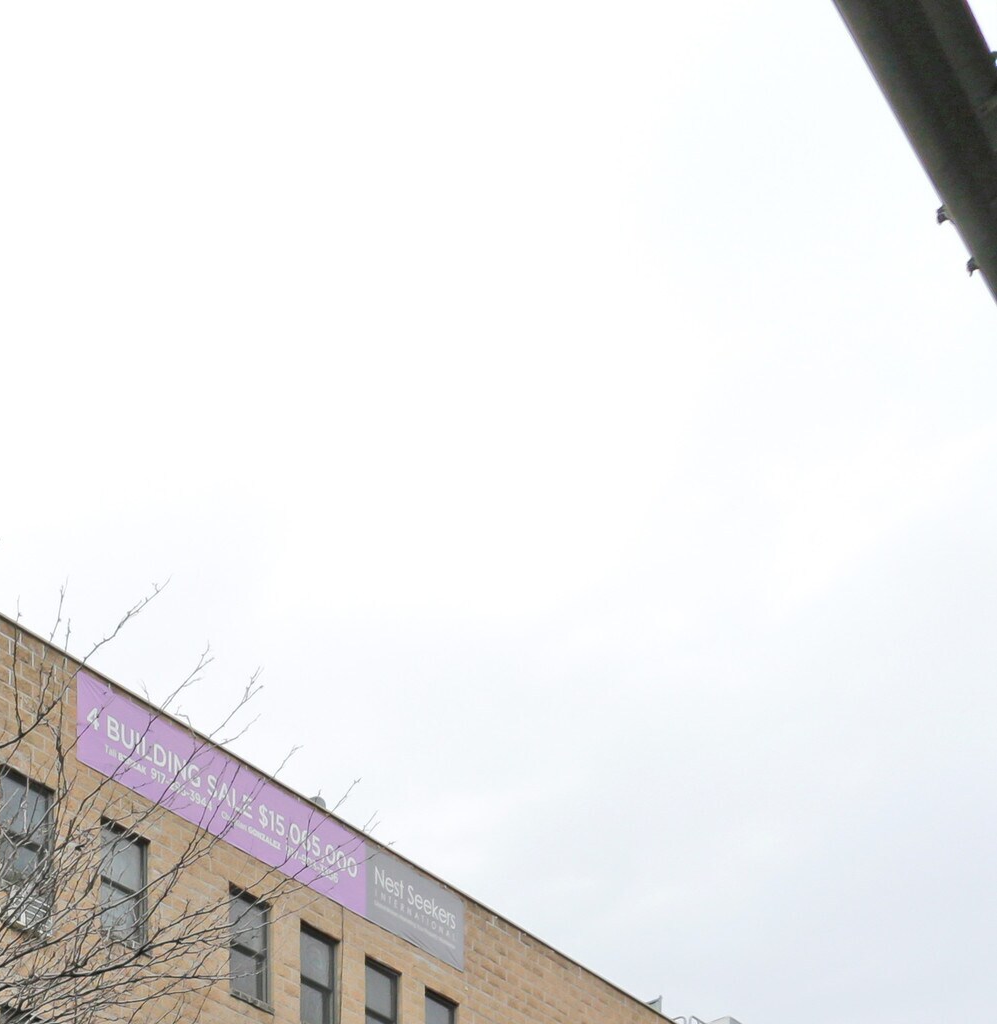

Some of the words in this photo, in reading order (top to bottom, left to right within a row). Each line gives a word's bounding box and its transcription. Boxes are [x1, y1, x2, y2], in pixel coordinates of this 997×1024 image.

[87, 708, 99, 730] 4
[107, 715, 201, 788] BUILDING
[207, 775, 253, 819] SALE
[374, 866, 404, 899] Nest
[407, 885, 456, 929] Seekers
